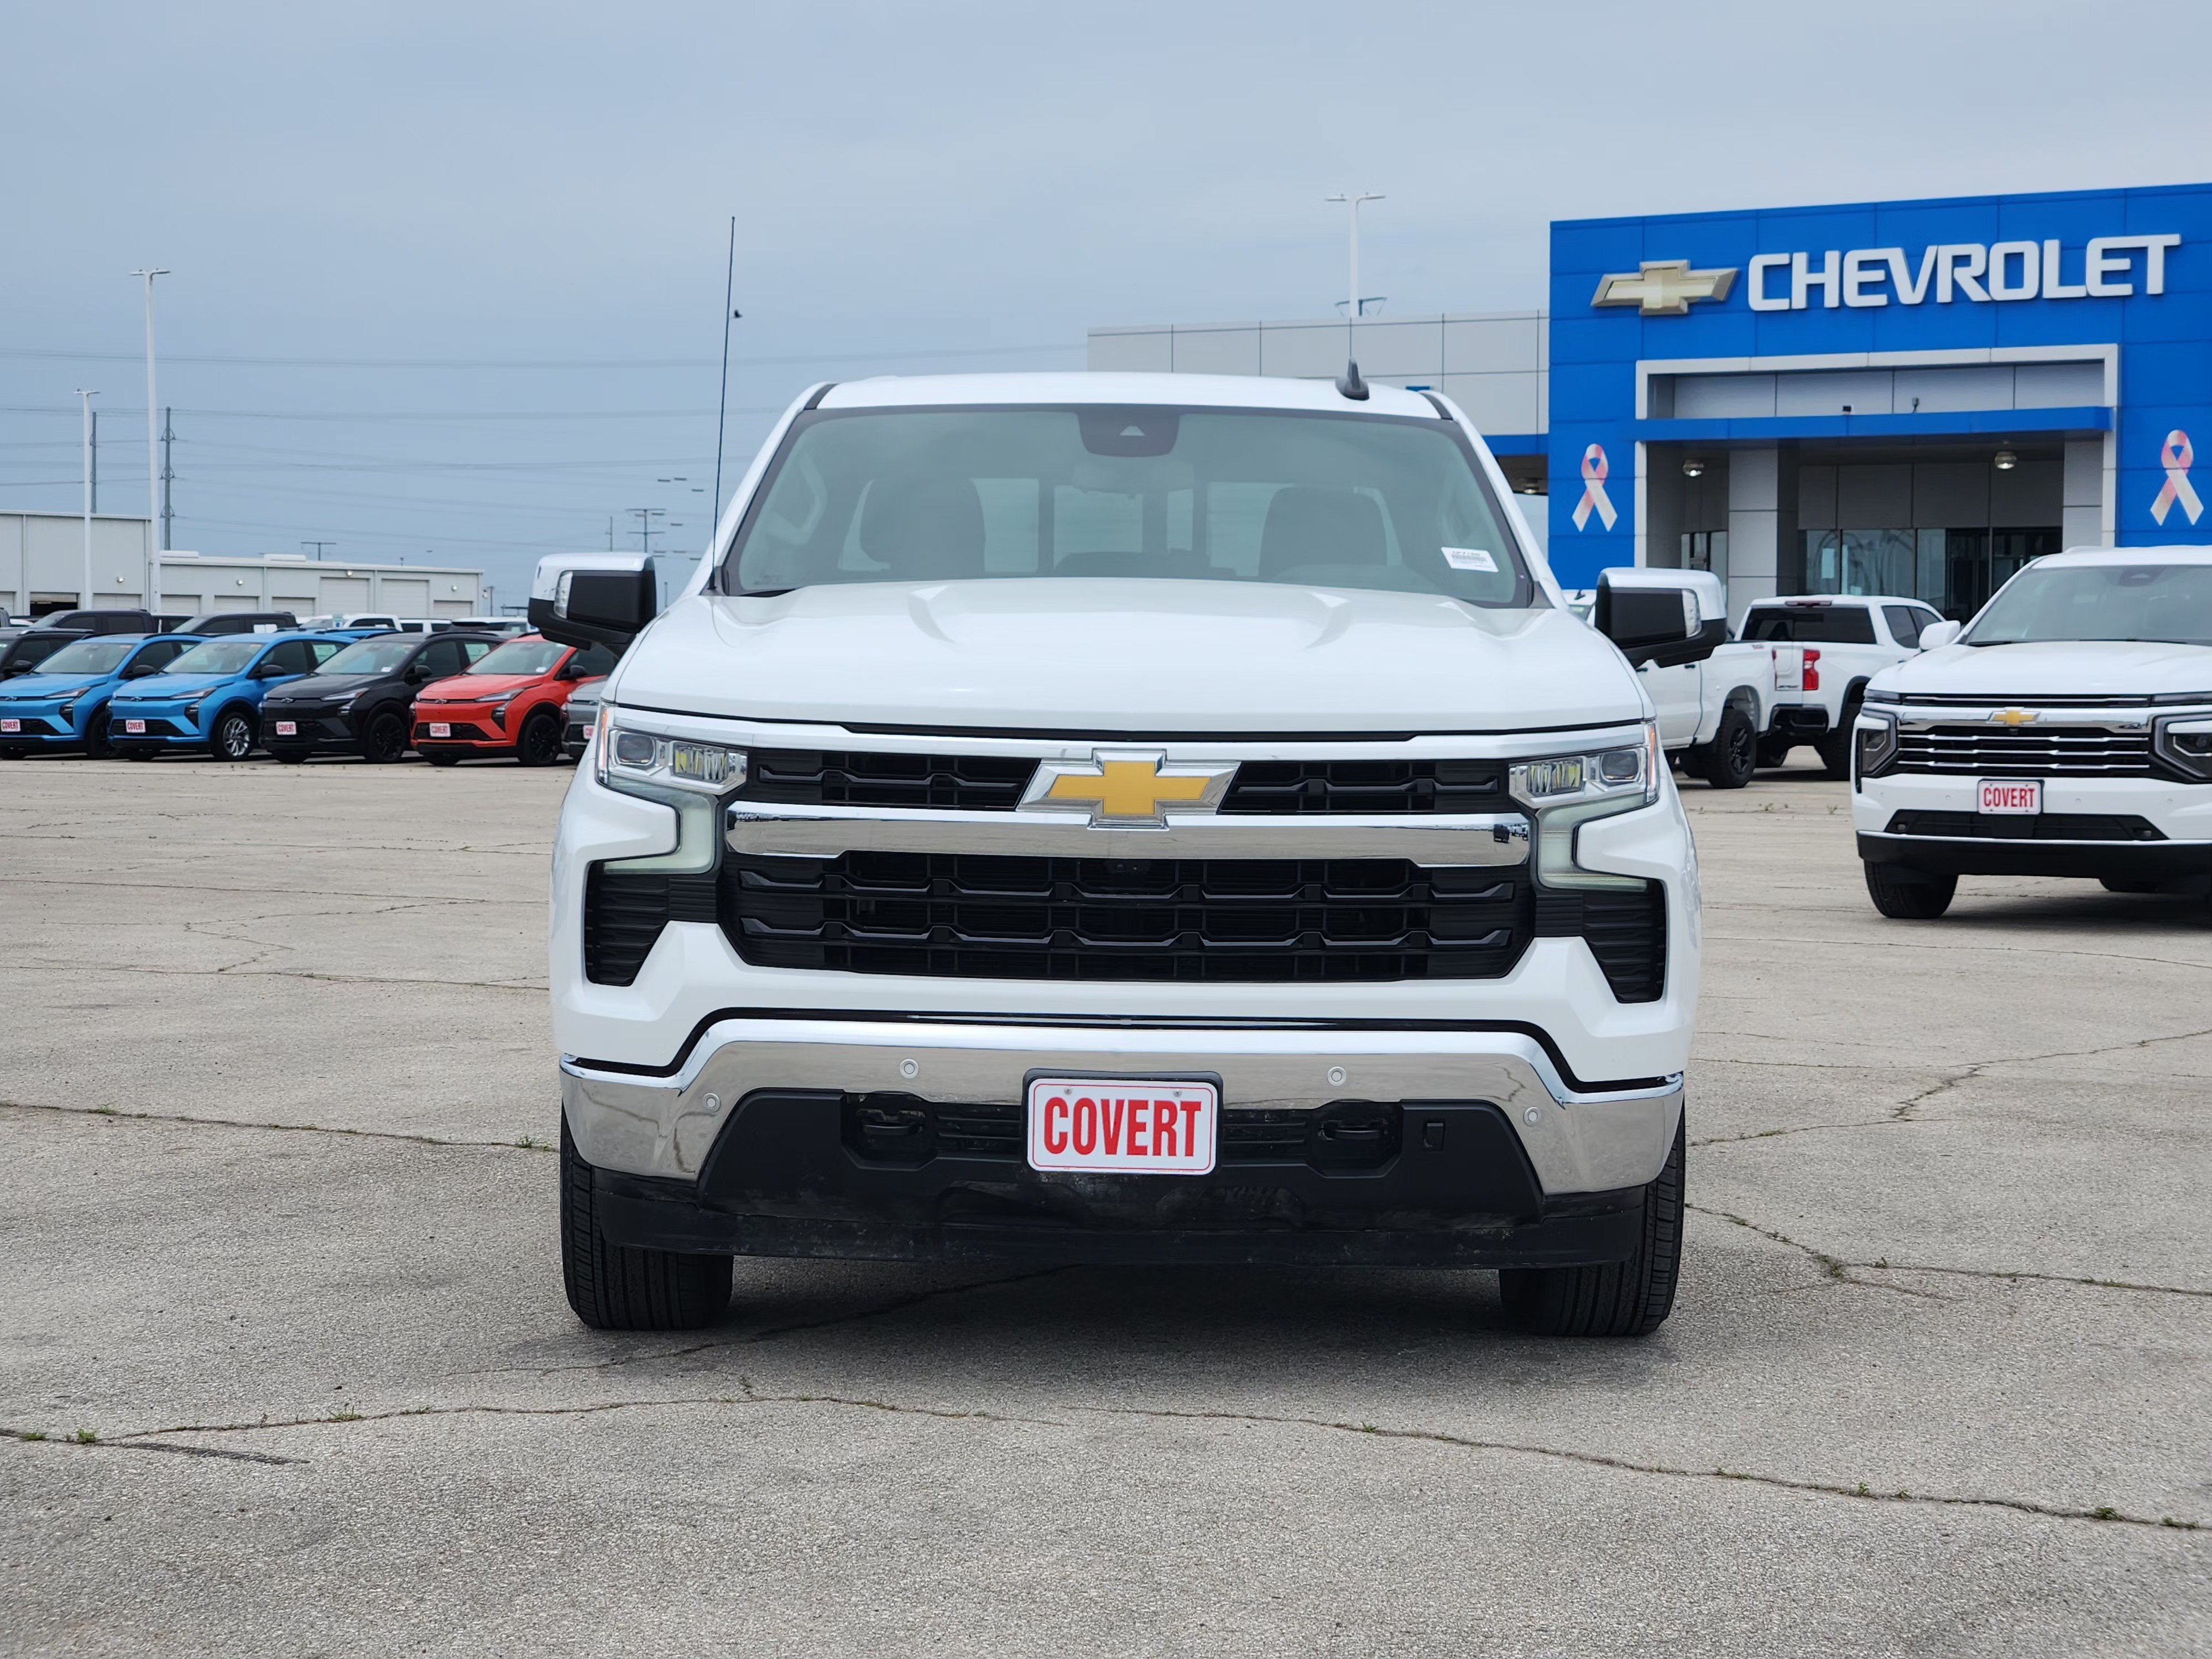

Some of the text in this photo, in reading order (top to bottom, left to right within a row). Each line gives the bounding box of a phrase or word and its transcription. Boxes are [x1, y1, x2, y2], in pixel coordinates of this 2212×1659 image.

[1749, 234, 2180, 311] CHEVROLET
[128, 722, 143, 730] COVERT
[1984, 787, 2035, 807] COVERT
[1044, 1097, 1202, 1157] COVERT
